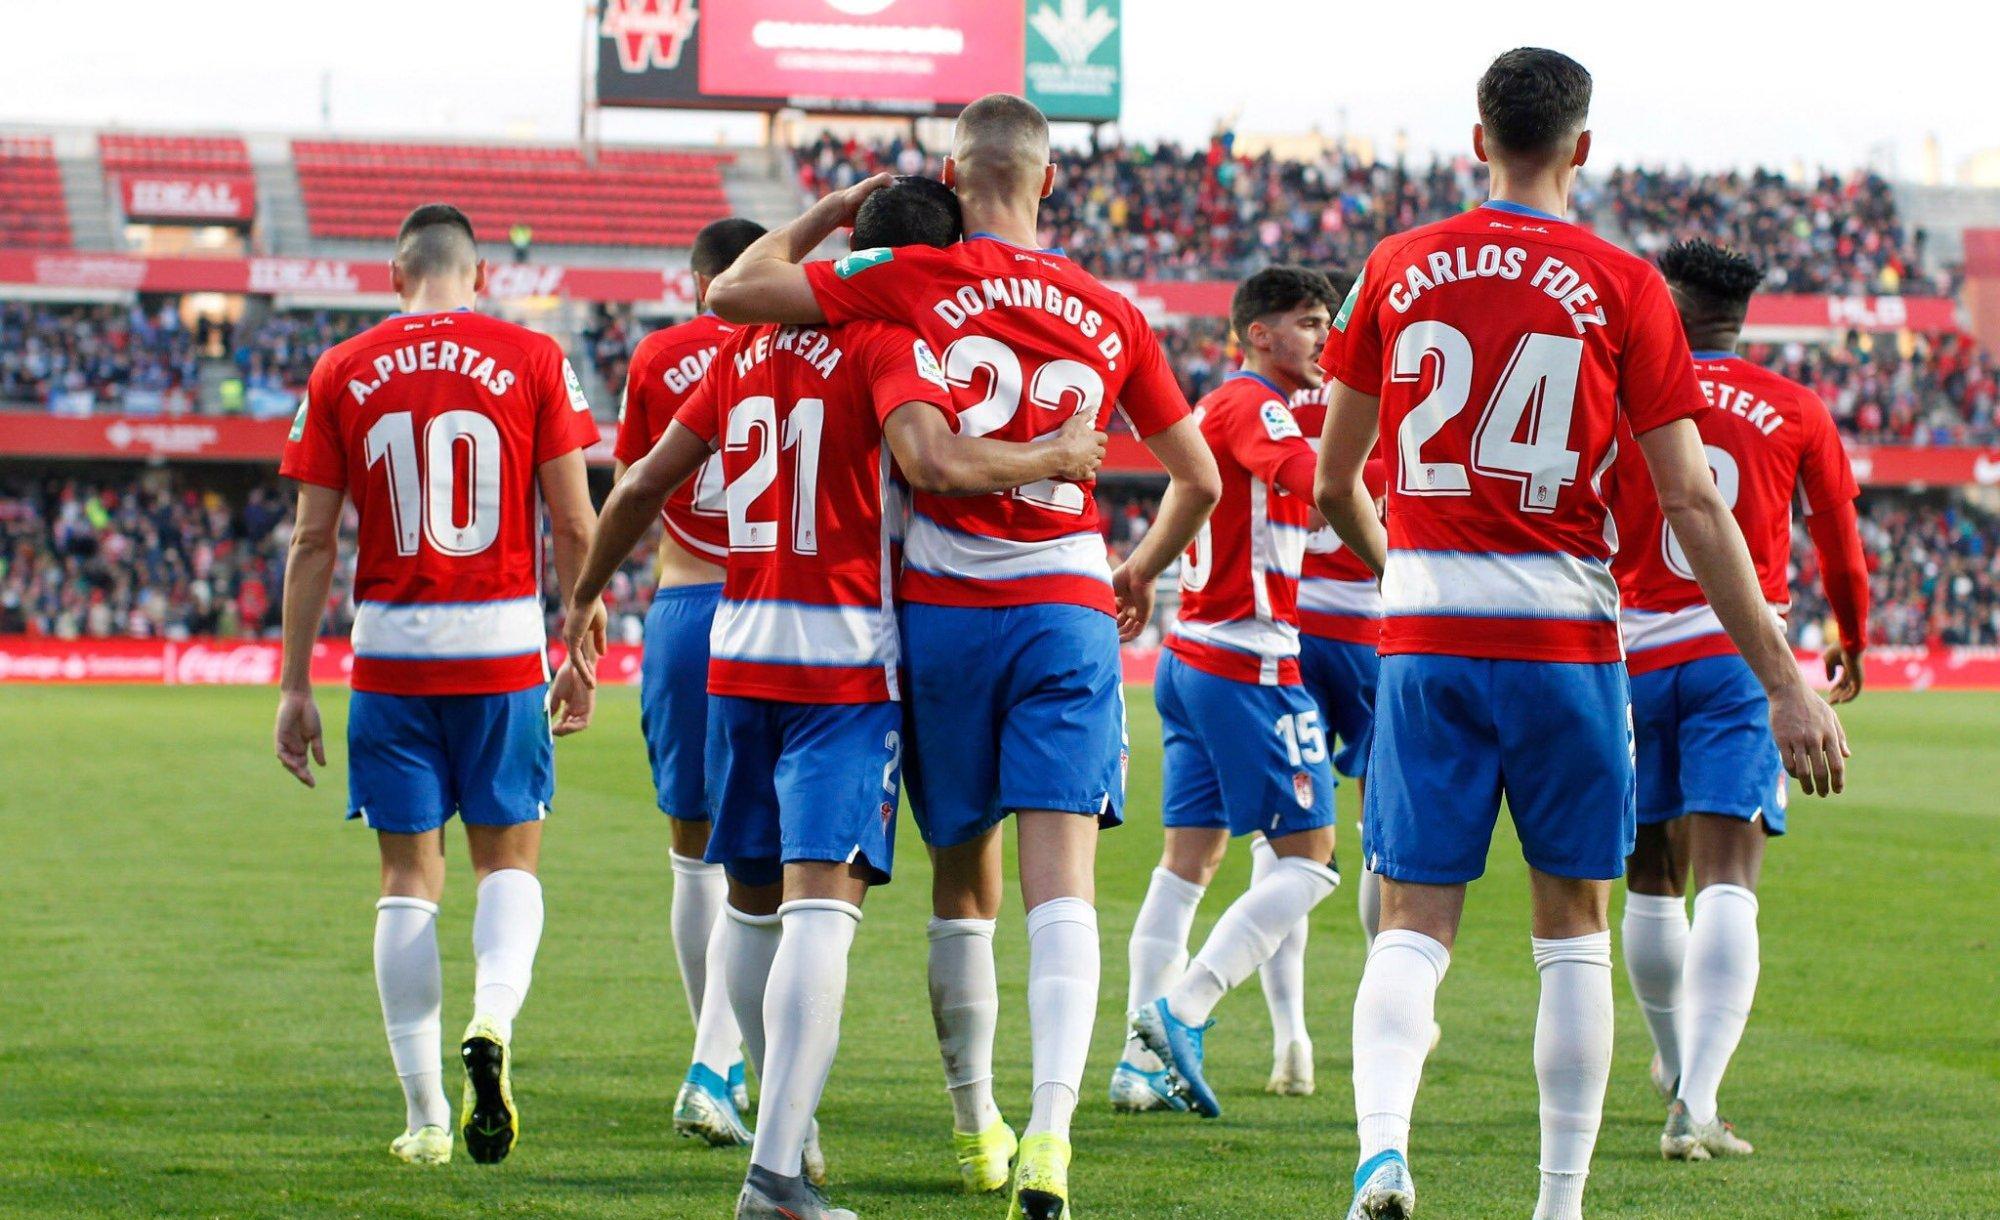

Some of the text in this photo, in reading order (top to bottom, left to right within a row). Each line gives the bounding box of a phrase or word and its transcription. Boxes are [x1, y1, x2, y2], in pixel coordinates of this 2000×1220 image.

[132, 180, 240, 210] IDEAL
[933, 277, 1122, 371] DOMINGOS D.
[1389, 244, 1607, 334] CARLOS FDEZ
[348, 341, 516, 405] A.PUERTAS
[1391, 320, 1584, 513] 24
[1699, 380, 1784, 436] ETEKI
[364, 409, 500, 556] 10
[726, 396, 824, 556] 21
[1275, 711, 1327, 766] 15
